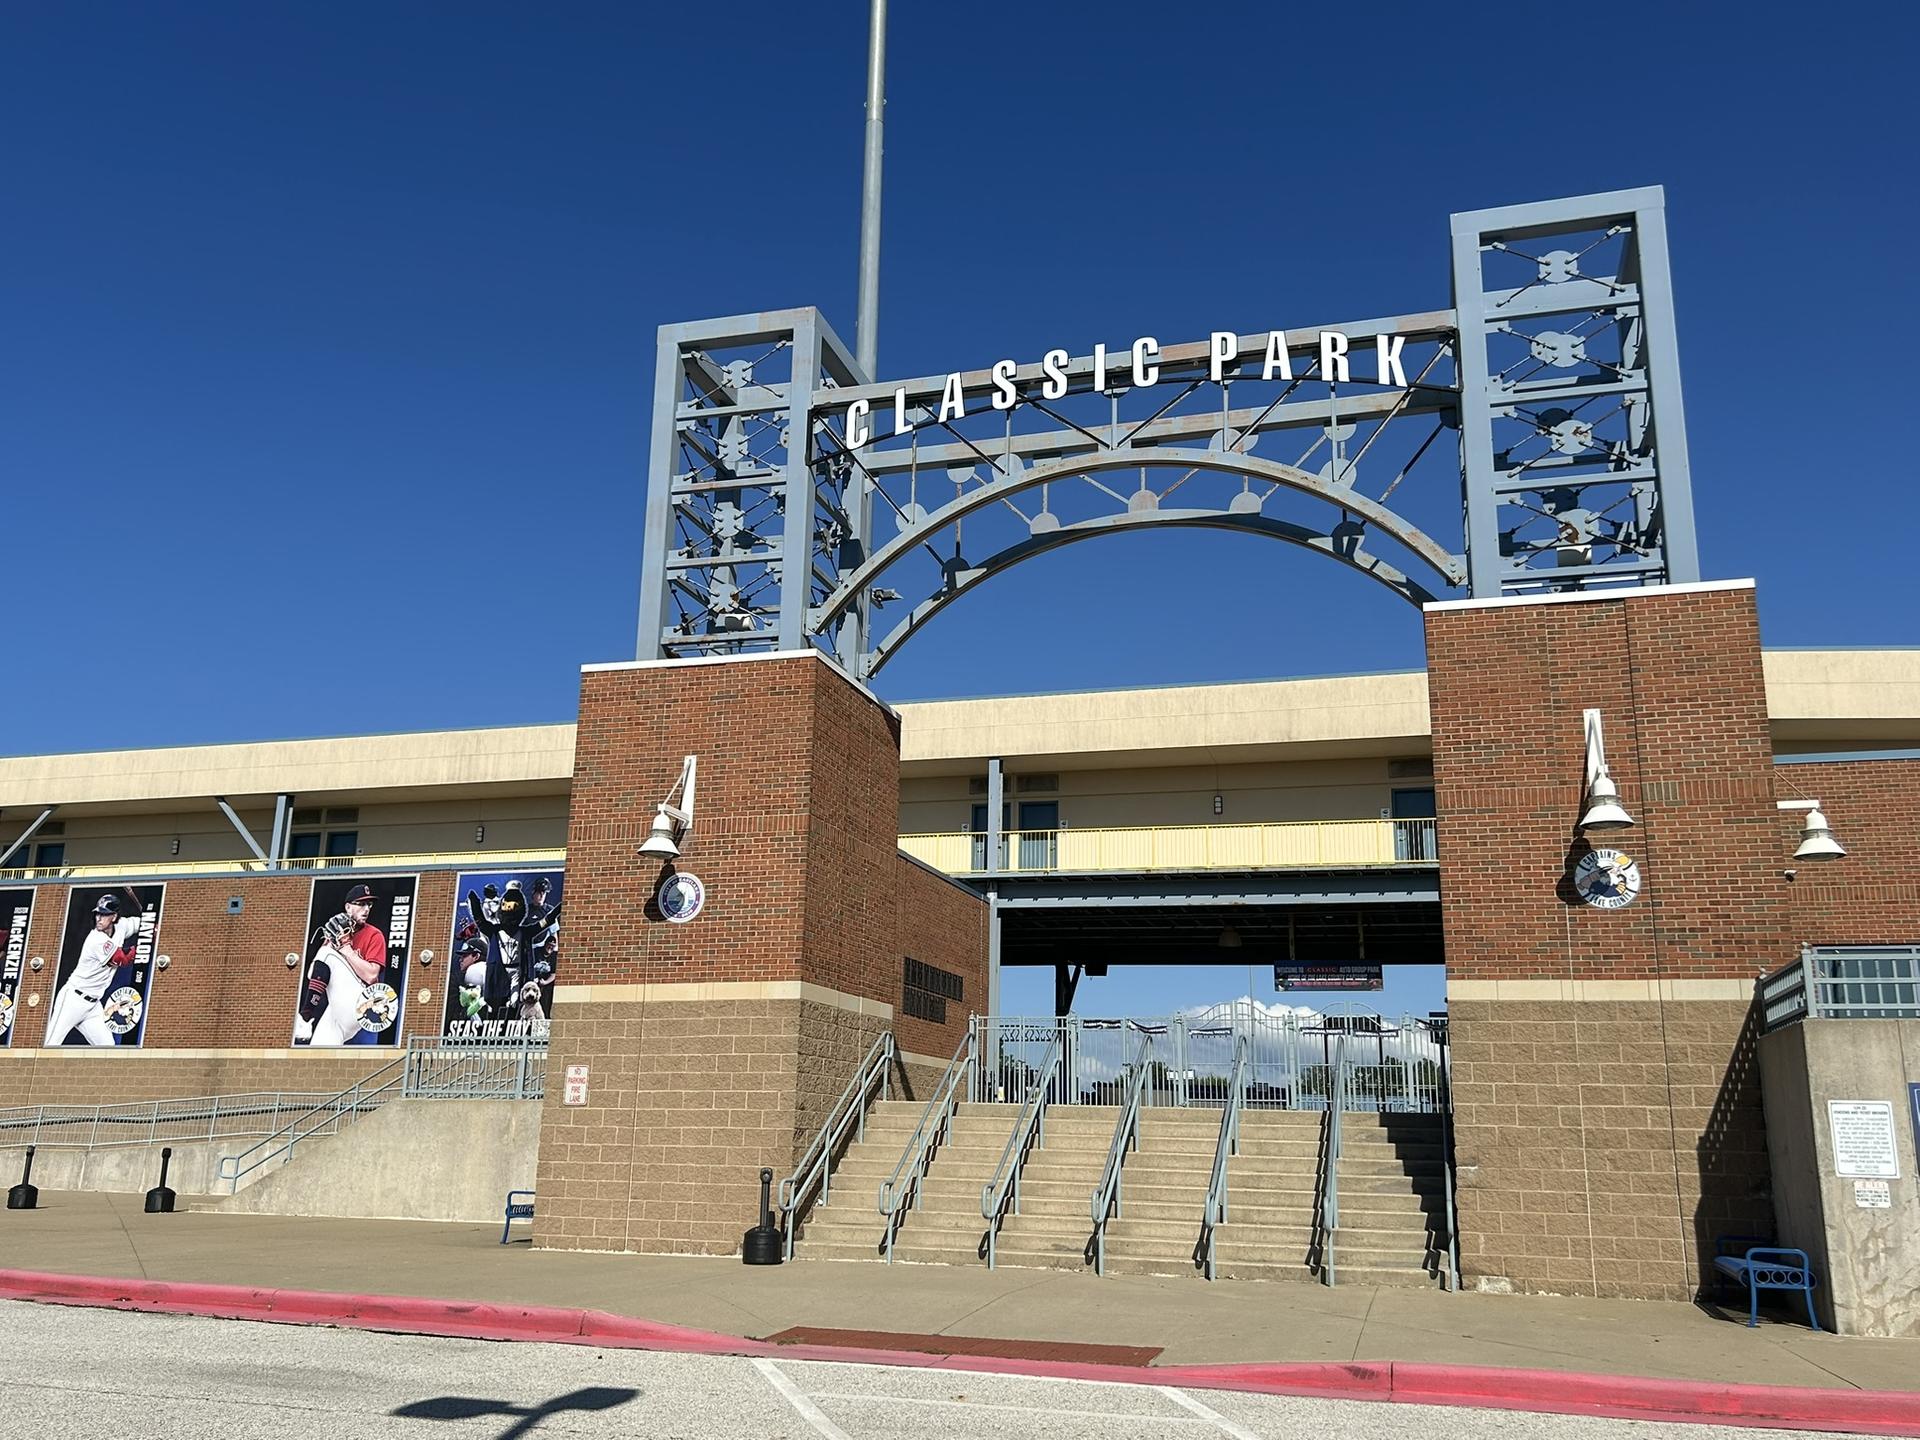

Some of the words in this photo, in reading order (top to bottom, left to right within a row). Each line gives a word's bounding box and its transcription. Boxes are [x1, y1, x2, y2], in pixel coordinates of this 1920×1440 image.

[845, 336, 1160, 450] CLASSIC
[1210, 330, 1408, 387] PARK
[1583, 850, 1617, 866] CAPTAINS
[1589, 894, 1606, 907] LAKE
[1608, 892, 1632, 907] COUNTY
[388, 904, 410, 949] BIBEE
[134, 911, 157, 965] NAYLOR
[2, 914, 29, 980] McKENZIE
[391, 954, 400, 969] 2022
[448, 1020, 480, 1037] SEAS
[482, 1020, 505, 1037] THE
[505, 1020, 532, 1037] DAY
[574, 1067, 582, 1075] NO
[569, 1095, 581, 1103] LANE
